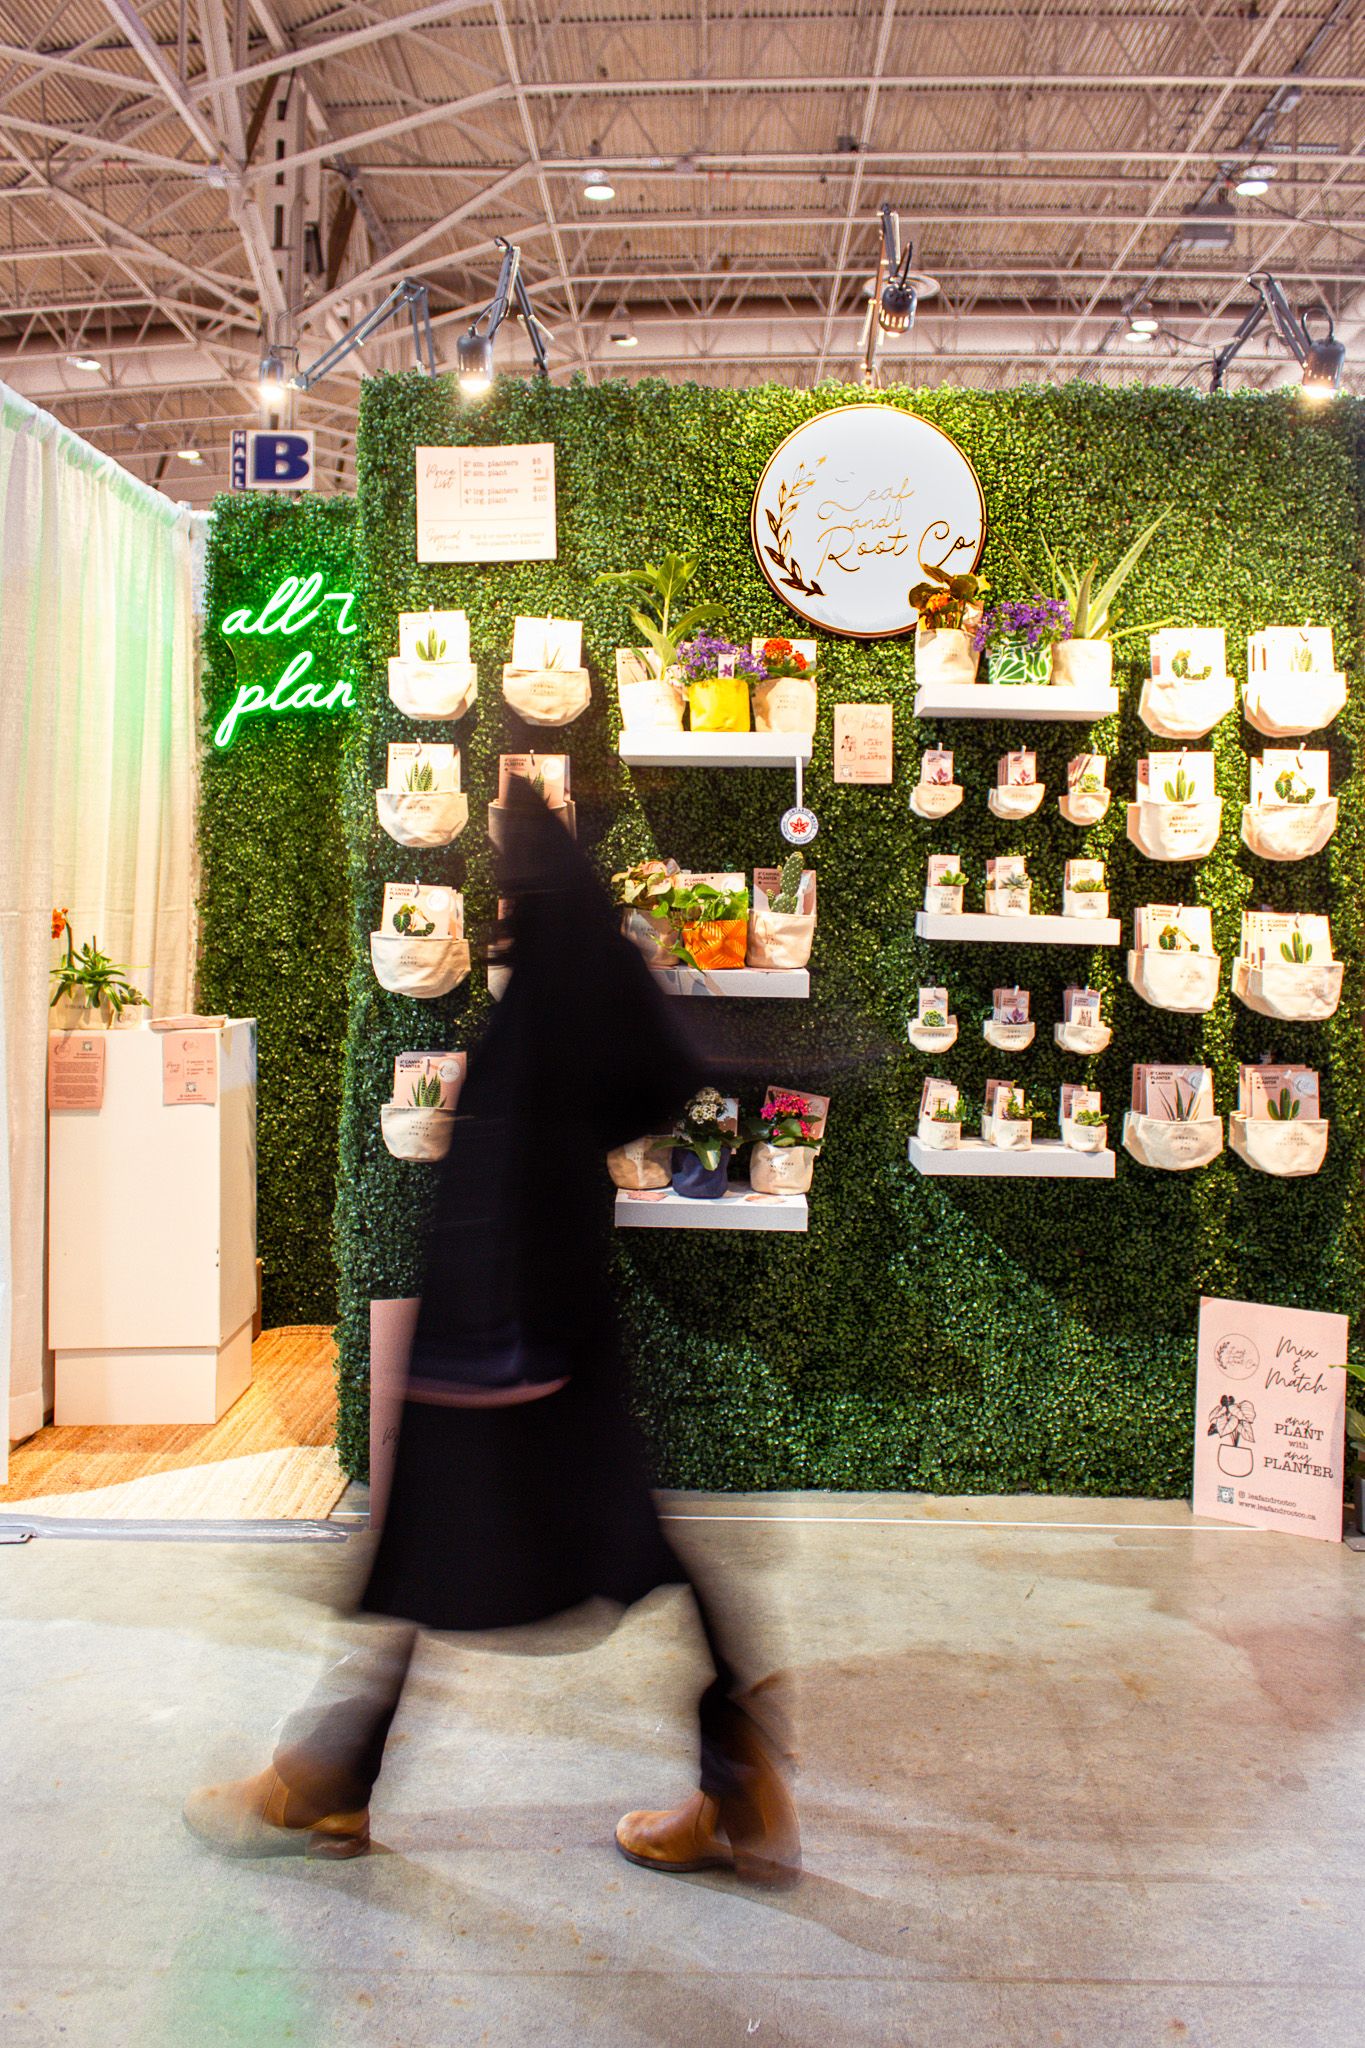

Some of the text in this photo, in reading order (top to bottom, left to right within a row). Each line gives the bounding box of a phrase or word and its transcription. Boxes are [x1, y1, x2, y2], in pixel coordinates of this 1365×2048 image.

[233, 432, 246, 487] HALL
[253, 434, 310, 483] B
[850, 504, 895, 529] and
[816, 526, 909, 576] Root
[221, 572, 323, 635] all
[1275, 1335, 1319, 1360] Mix
[1292, 1357, 1301, 1375] &
[1264, 1367, 1328, 1395] Match
[1273, 1423, 1324, 1441] PLANT
[1284, 1416, 1313, 1431] any
[1288, 1440, 1309, 1450] with
[1263, 1456, 1334, 1479] PLANTER
[1284, 1451, 1312, 1466] any
[1248, 1492, 1297, 1507] leafandrootco
